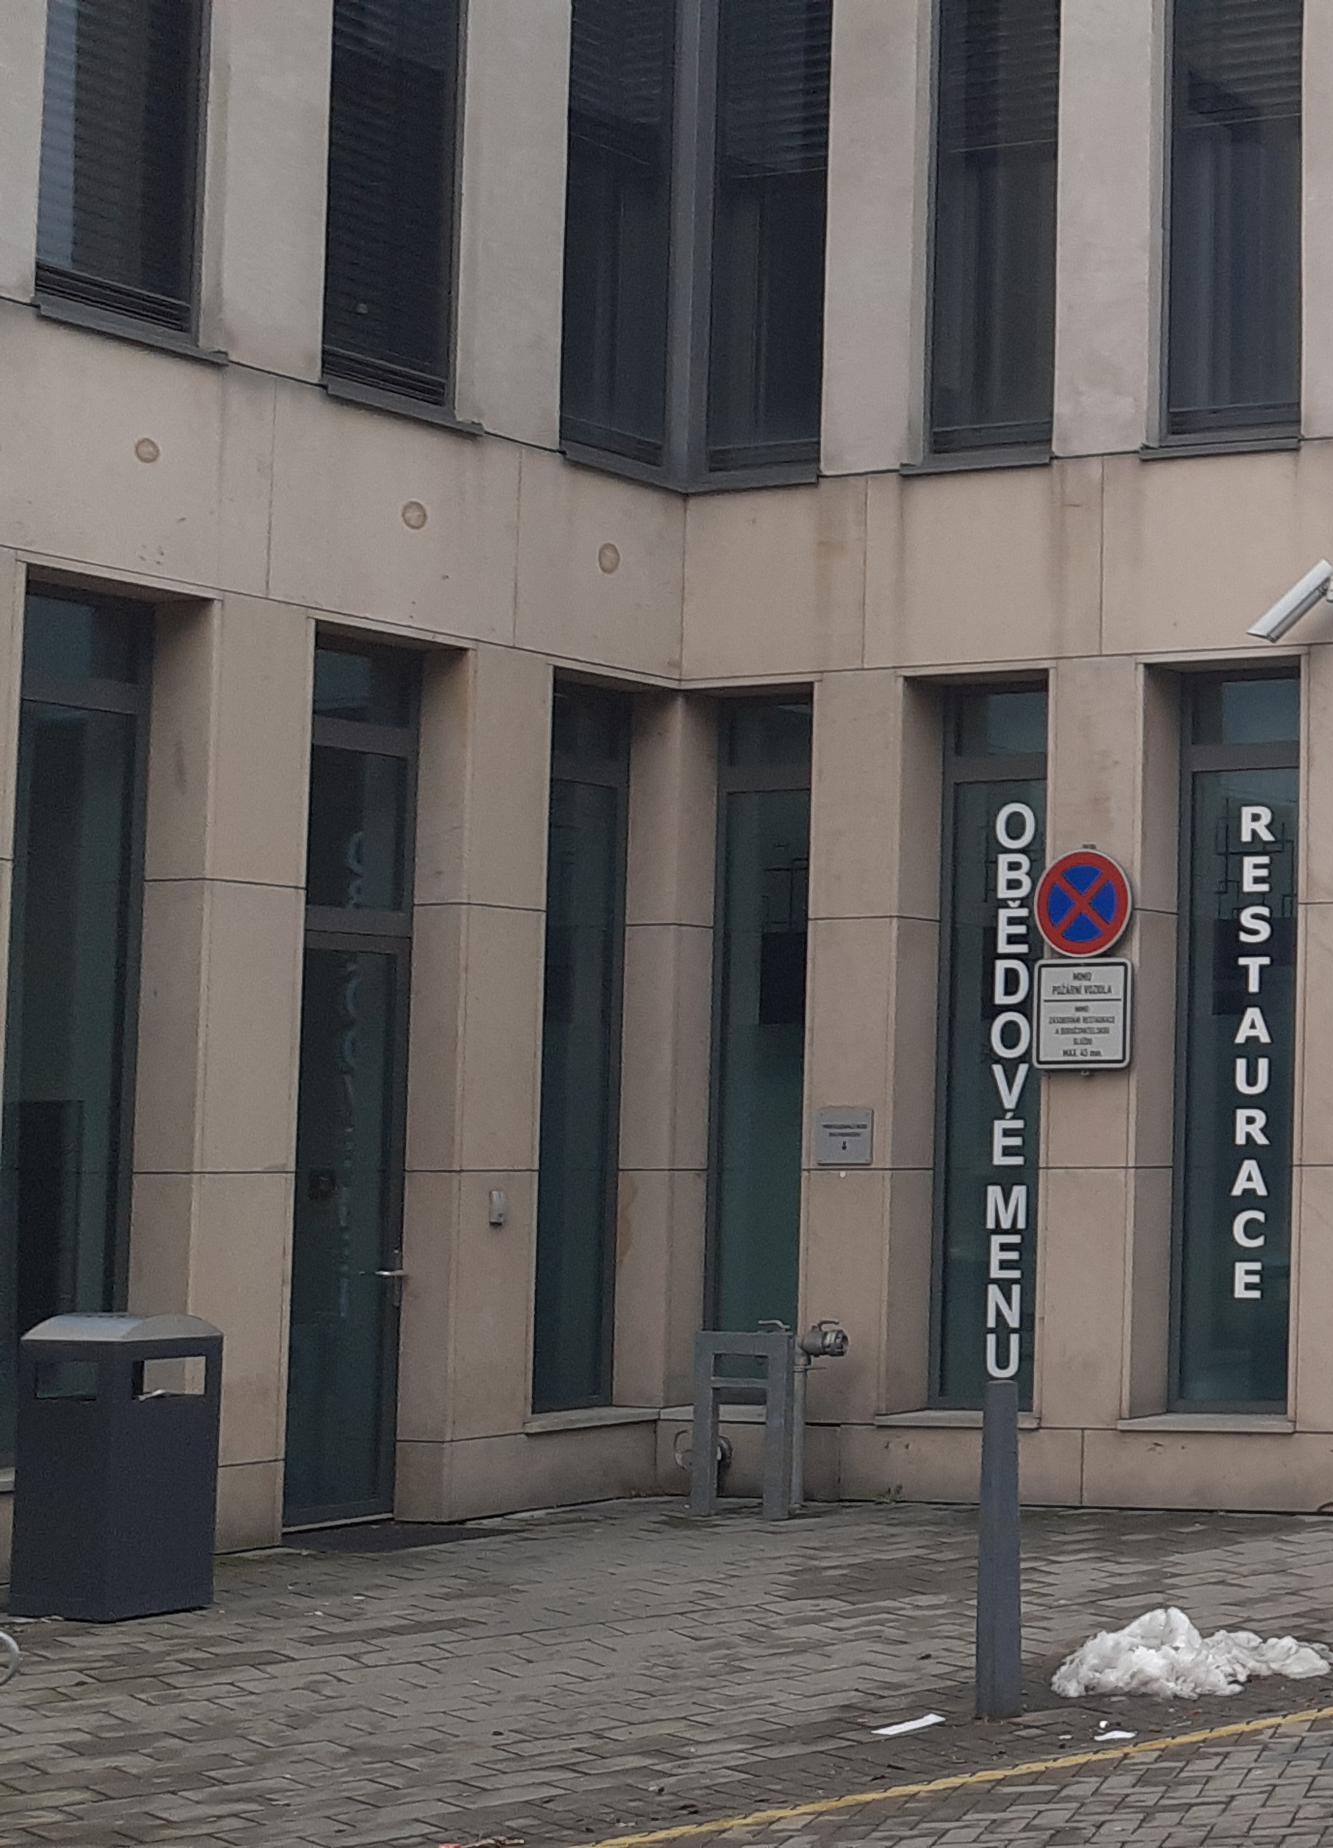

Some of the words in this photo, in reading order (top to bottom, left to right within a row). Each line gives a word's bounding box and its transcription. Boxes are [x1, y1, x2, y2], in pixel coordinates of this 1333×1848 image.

[990, 802, 1036, 1167] OBĚDOVÉ
[1230, 806, 1275, 1299] RESTAURACE
[985, 1184, 1027, 1379] MENU
